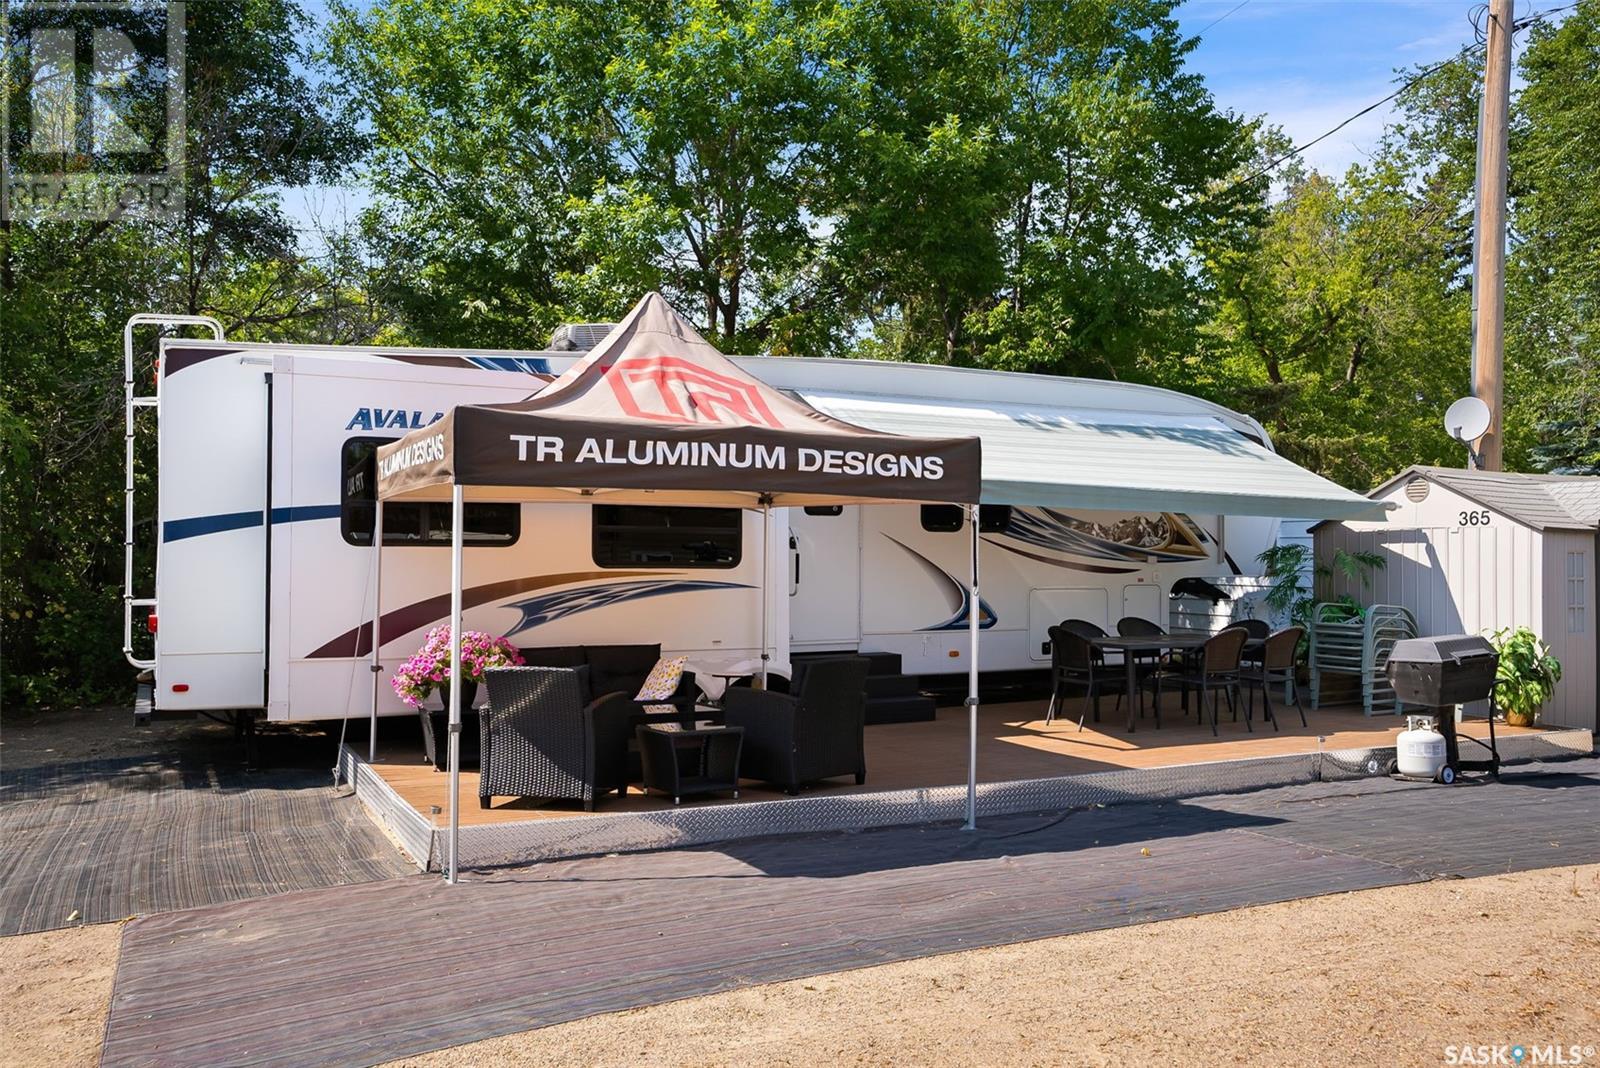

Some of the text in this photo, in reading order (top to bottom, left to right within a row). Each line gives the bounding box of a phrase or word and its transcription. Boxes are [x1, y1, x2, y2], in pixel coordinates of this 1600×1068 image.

[411, 433, 444, 466] DESIGNS
[510, 434, 944, 480] TR ALUMINUM DESIGNS
[1459, 510, 1491, 526] 365
